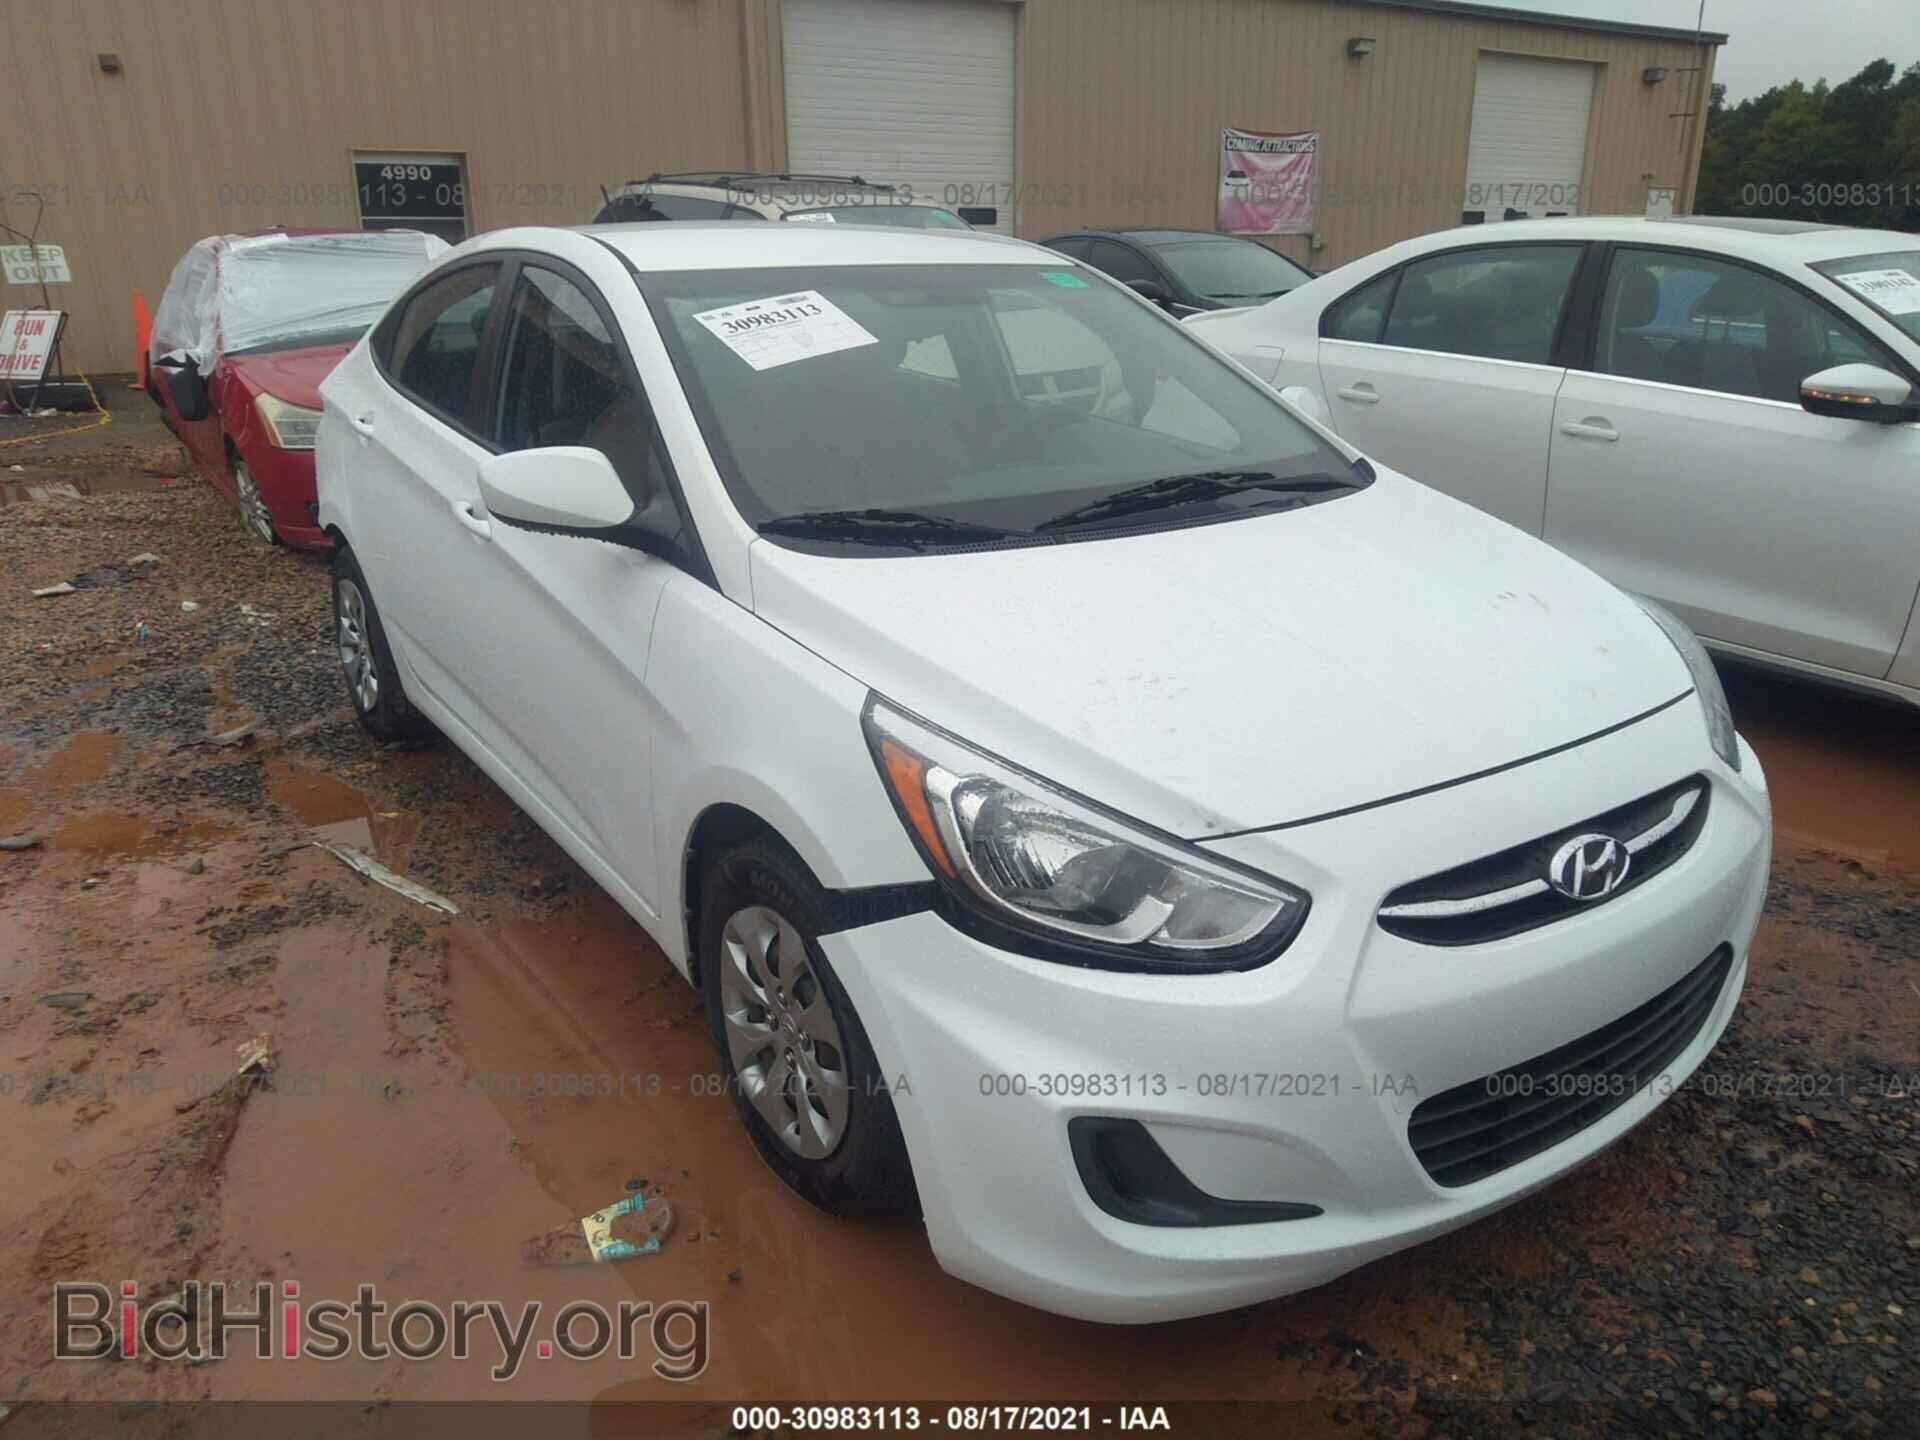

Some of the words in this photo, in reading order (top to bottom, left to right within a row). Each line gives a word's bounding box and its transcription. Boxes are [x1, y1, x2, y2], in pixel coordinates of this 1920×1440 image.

[1260, 139, 1314, 153] ATTRACTIONS
[380, 164, 432, 181] 4990
[4, 248, 61, 263] KEEP
[14, 264, 62, 281] OUT
[721, 303, 823, 334] 30983113
[14, 319, 46, 336] RUN
